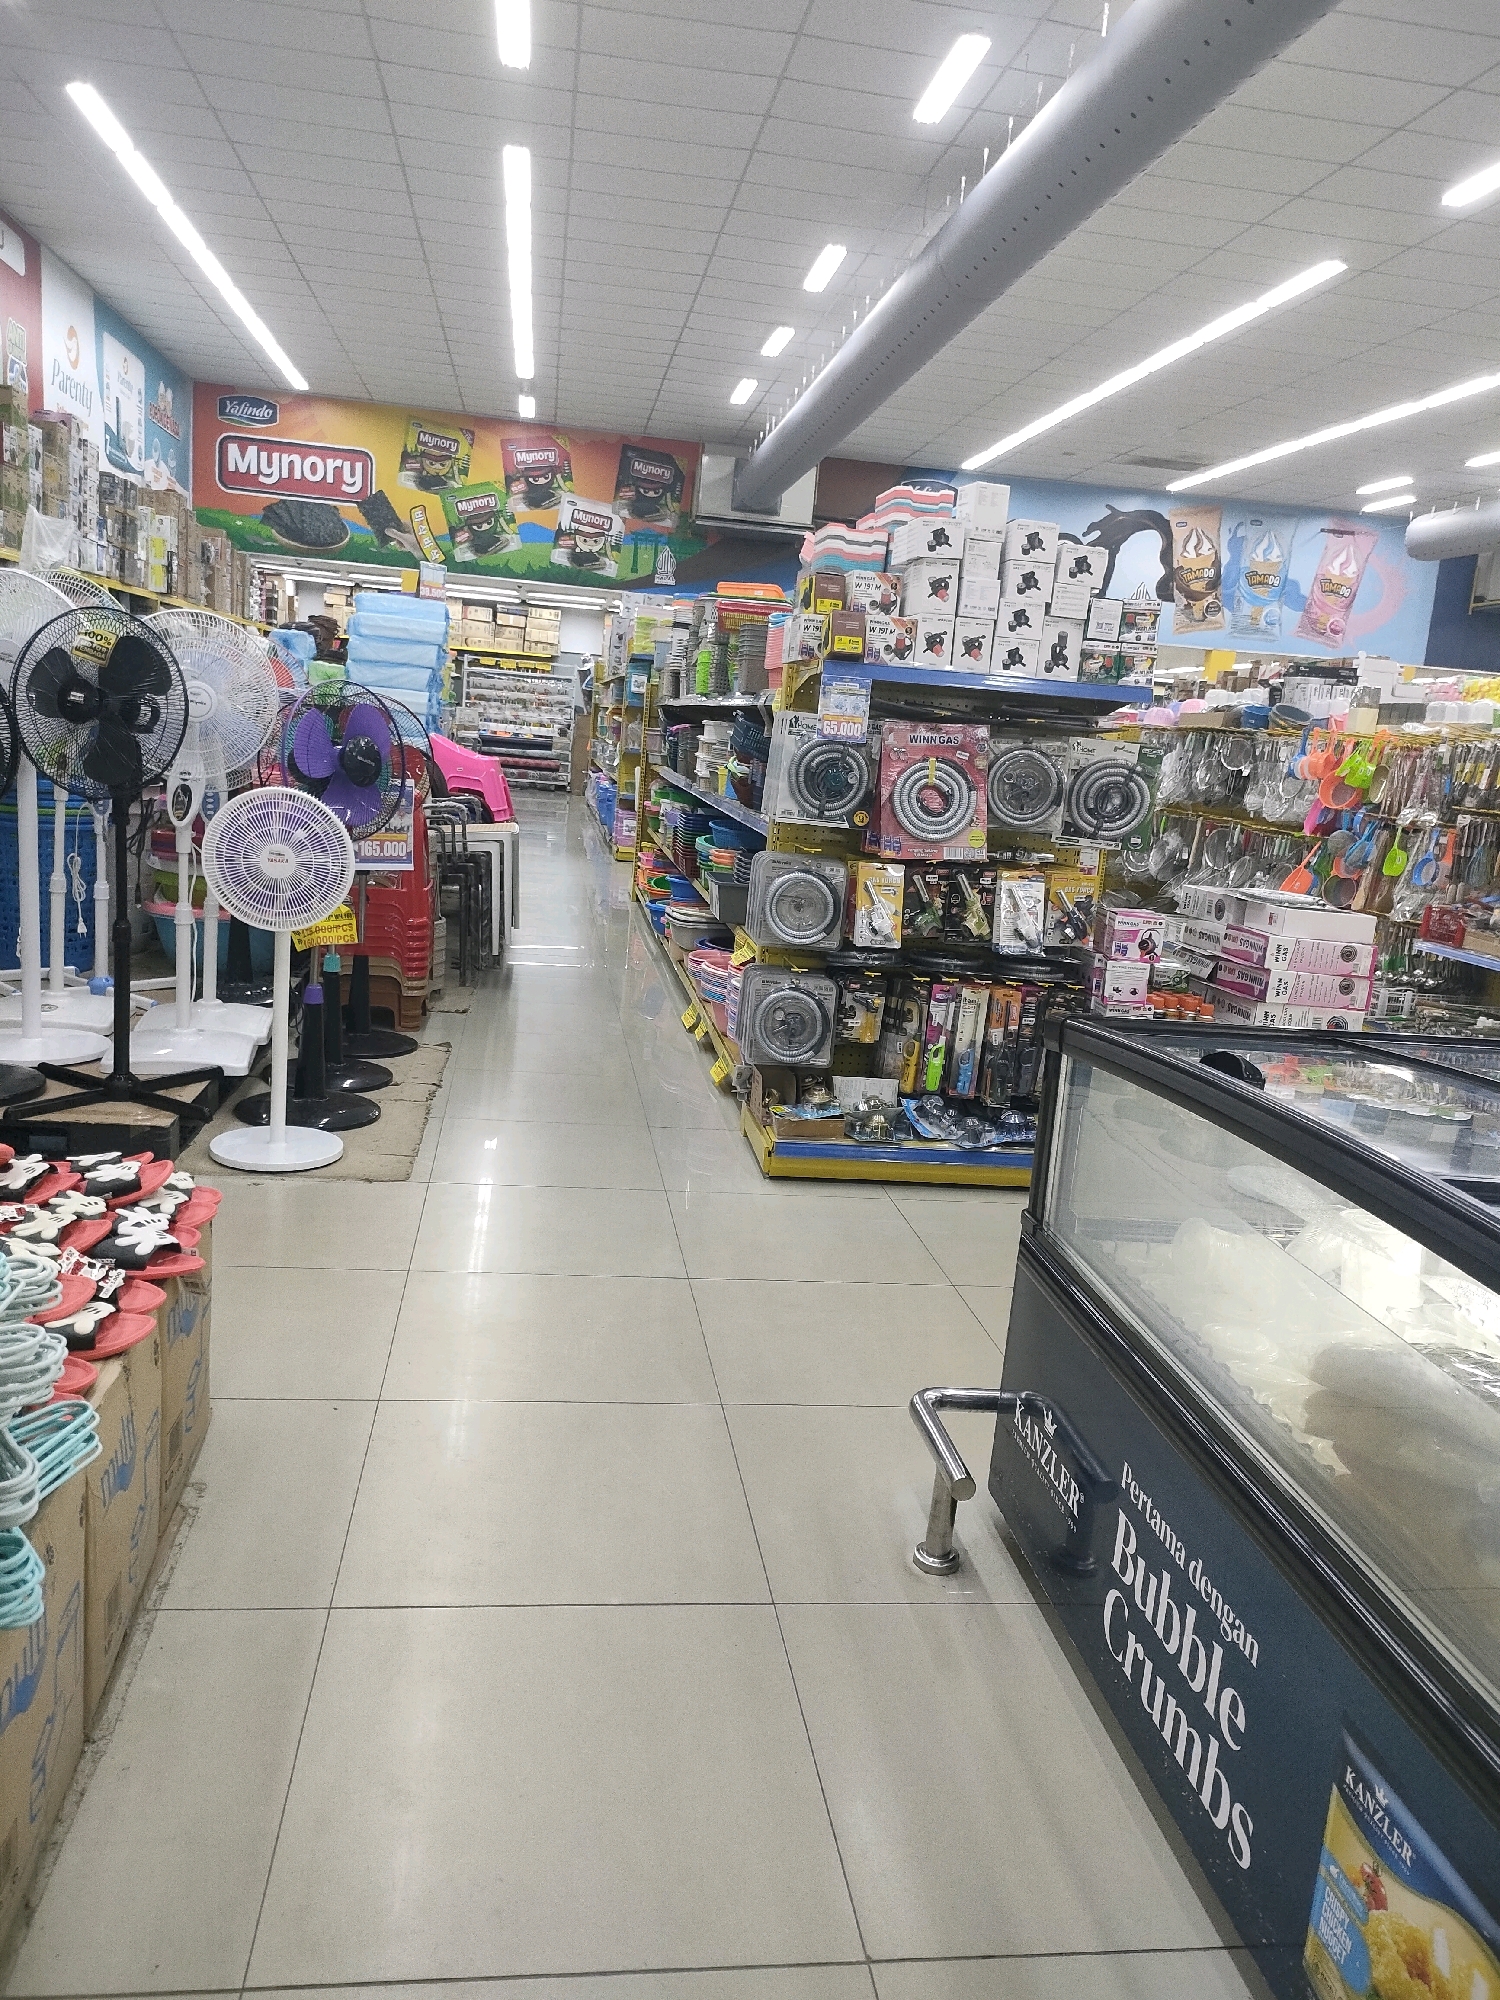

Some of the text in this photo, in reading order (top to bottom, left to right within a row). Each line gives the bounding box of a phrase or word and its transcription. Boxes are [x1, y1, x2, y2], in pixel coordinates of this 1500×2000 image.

[51, 356, 93, 416] Parenty
[225, 400, 273, 417] Yafindo
[419, 432, 458, 450] Mynory
[516, 449, 555, 462] Mynory
[227, 443, 363, 493] Mynory
[634, 461, 671, 478] Mynory
[457, 495, 496, 512] Mynory
[573, 509, 611, 527] Mynory
[84, 631, 112, 646] 100%
[823, 721, 862, 737] 65.000
[358, 841, 407, 857] 165.000
[1274, 944, 1282, 963] WINN
[1014, 1397, 1081, 1519] KANZLER
[1120, 1460, 1260, 1669] Pertama dengan
[1111, 1507, 1248, 1752] Bubble
[1102, 1588, 1255, 1871] Crumbs
[1345, 1765, 1412, 1867] KANZLER
[1324, 1886, 1350, 1929] CRISPY
[1319, 1917, 1347, 1964] NUGGET
[1322, 1901, 1352, 1954] CHICKEN
